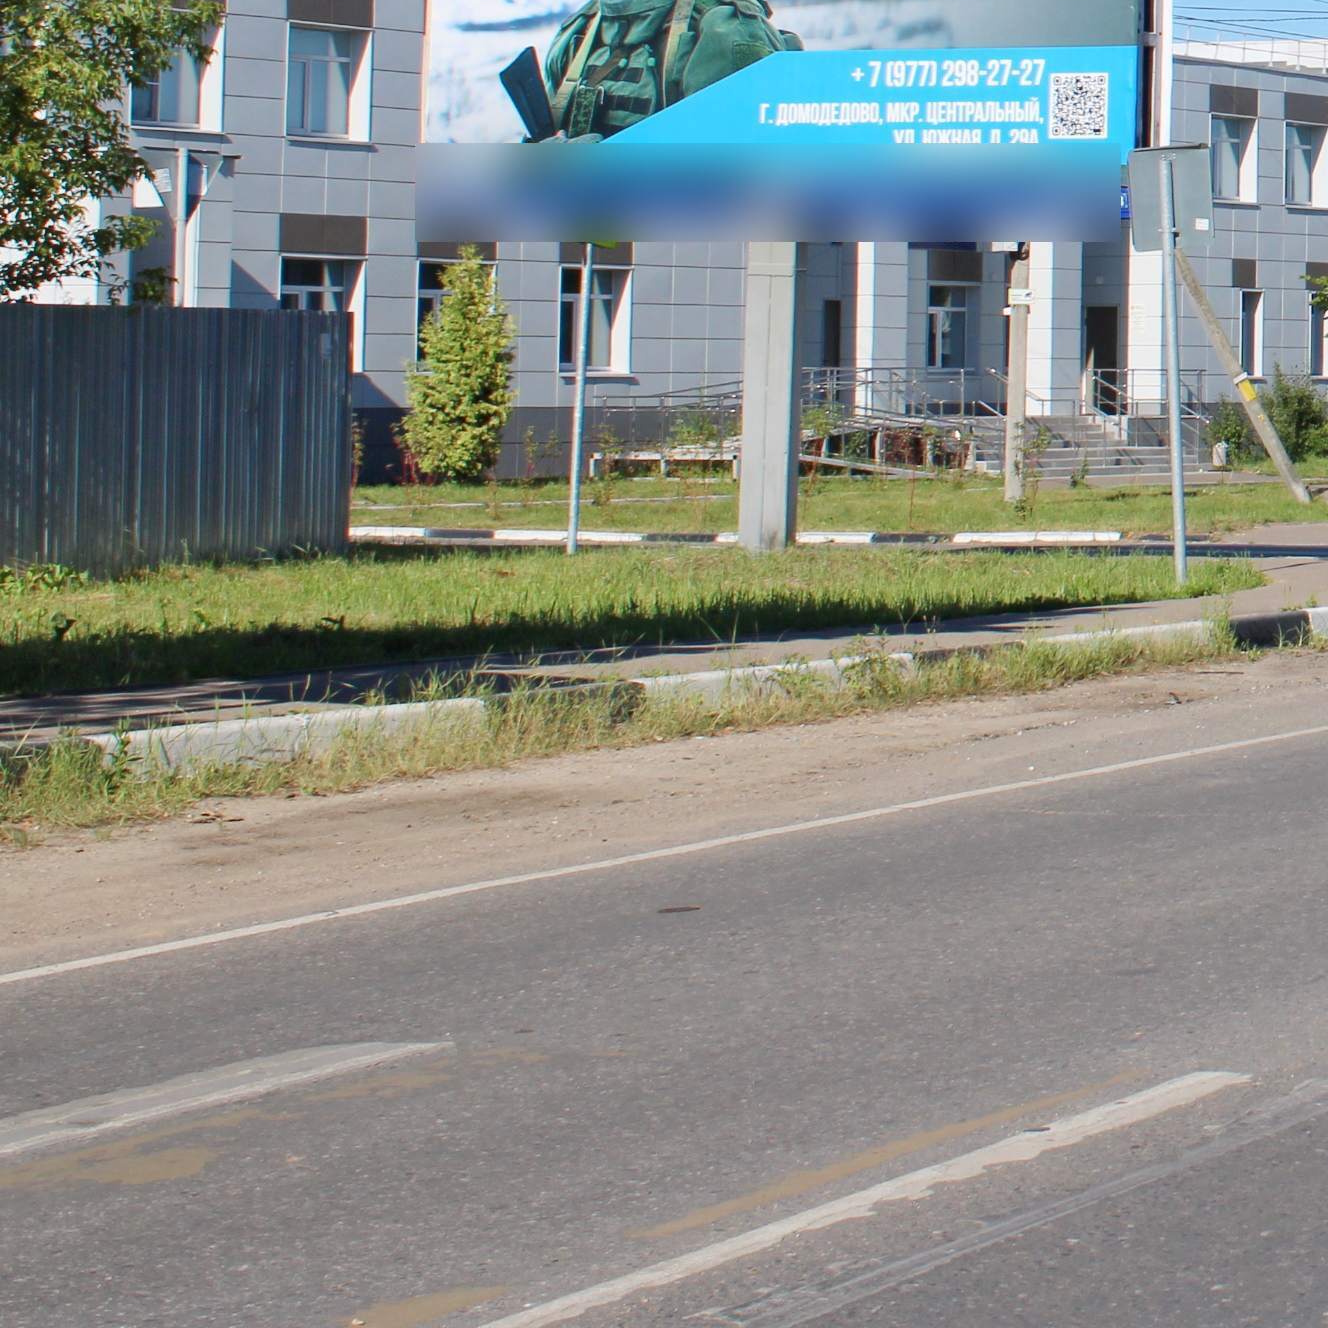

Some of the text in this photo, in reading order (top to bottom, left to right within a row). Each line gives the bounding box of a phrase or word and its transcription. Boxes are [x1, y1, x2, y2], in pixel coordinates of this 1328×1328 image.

[851, 59, 1045, 87] + 7 (977) 298-27-27
[760, 97, 1044, 126] Г. ДОМОДЕДОВО, МКР. ЦЕНТРАЛЬНЫЙ,
